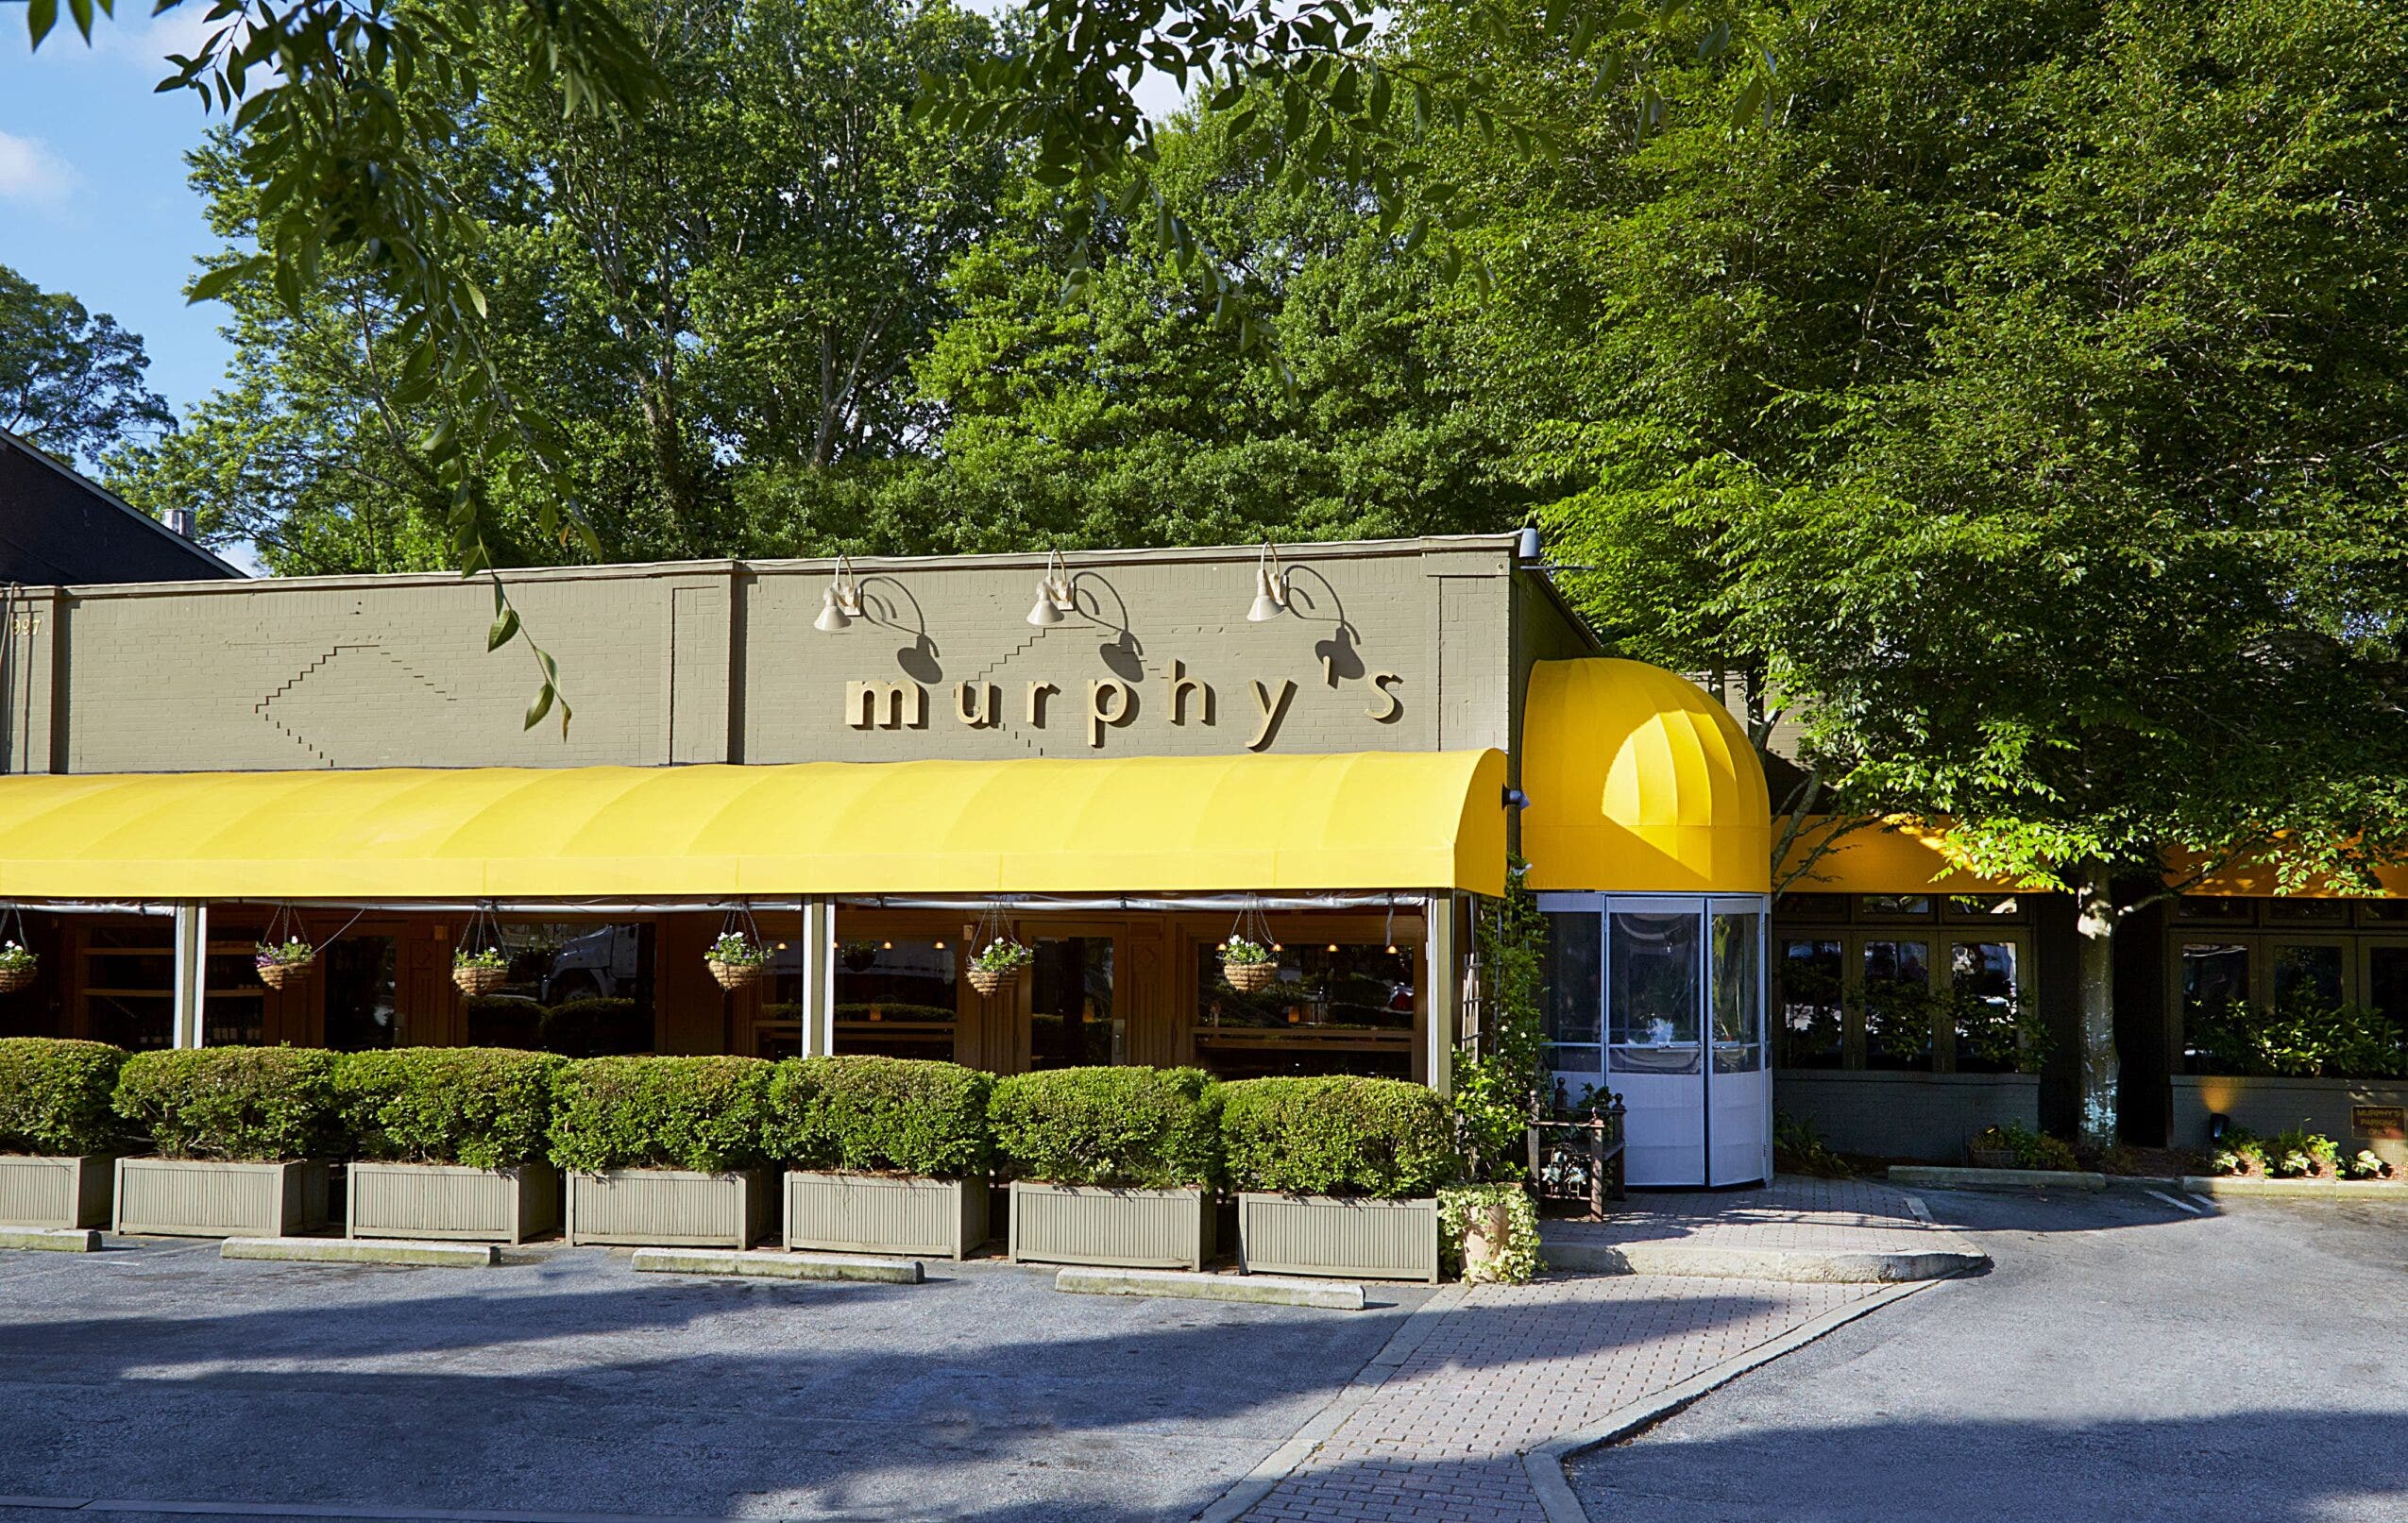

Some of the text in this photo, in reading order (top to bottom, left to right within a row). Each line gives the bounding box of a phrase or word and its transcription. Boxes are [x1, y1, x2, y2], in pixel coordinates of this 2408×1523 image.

[12, 618, 42, 635] 997
[845, 656, 1404, 752] murphy's
[2356, 1109, 2400, 1118] MURPHY'S
